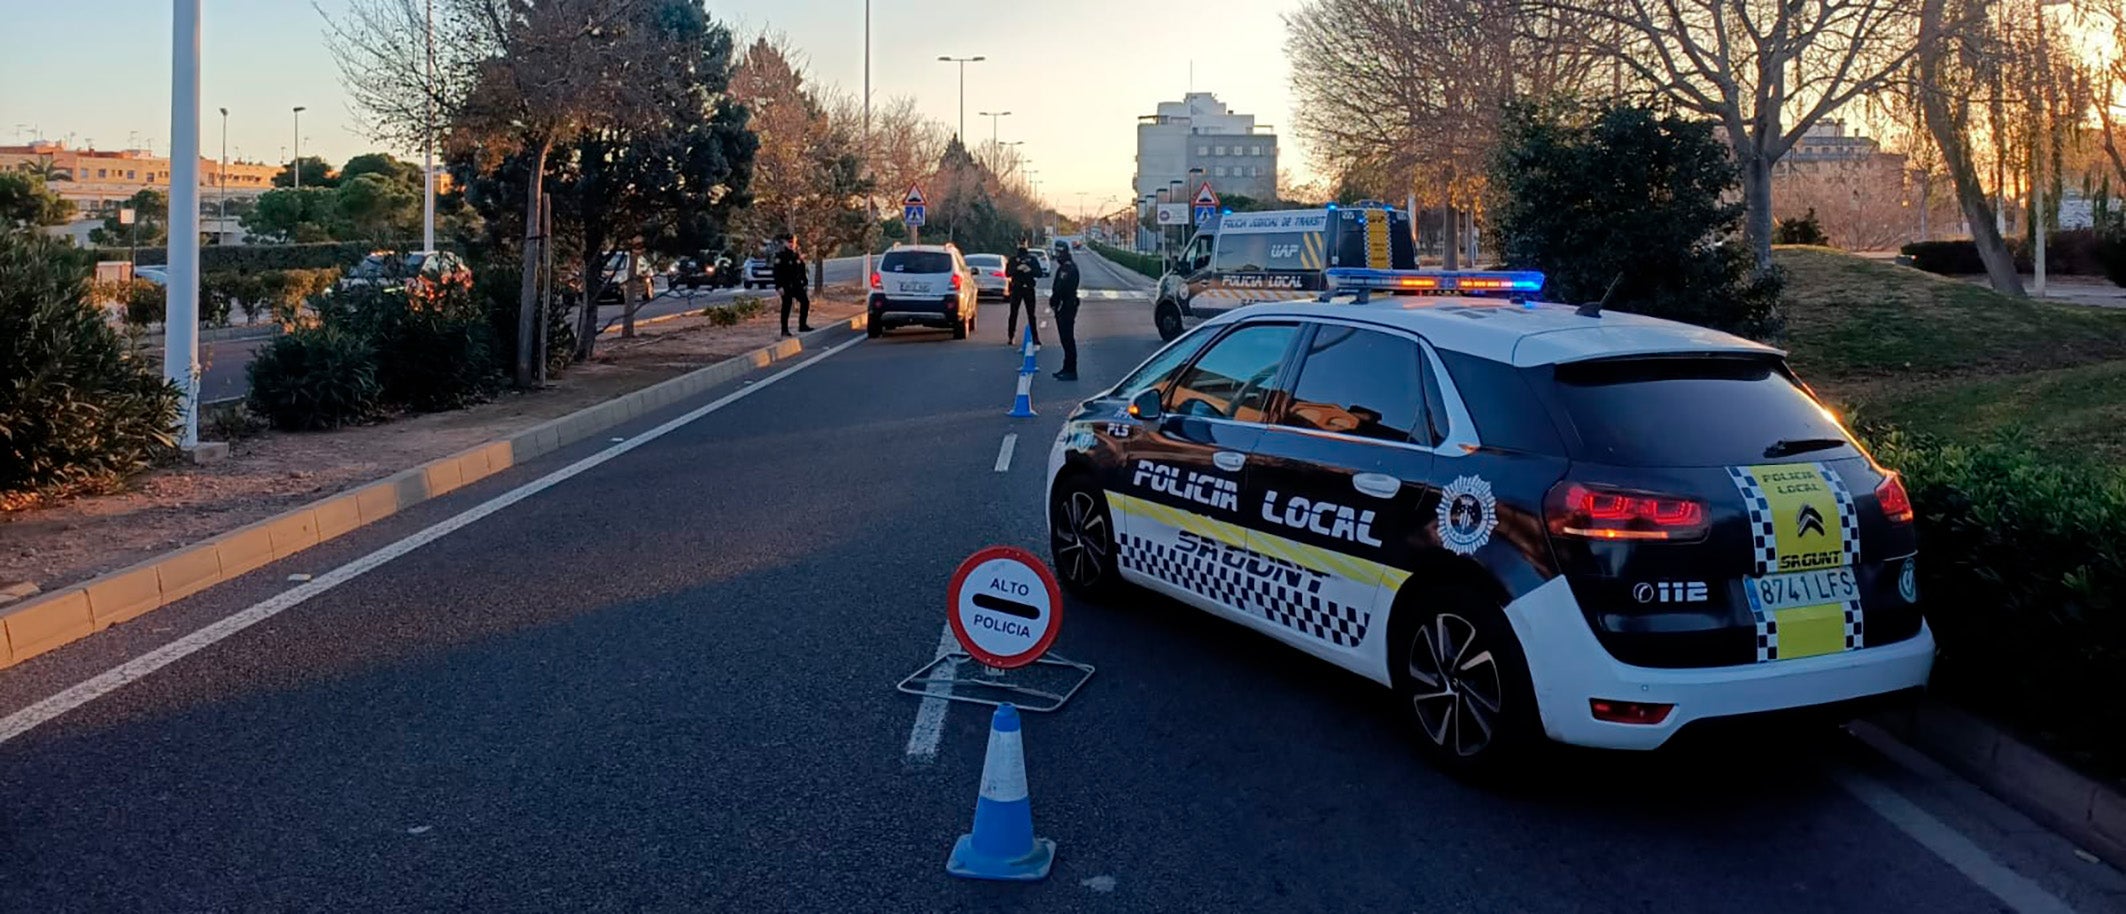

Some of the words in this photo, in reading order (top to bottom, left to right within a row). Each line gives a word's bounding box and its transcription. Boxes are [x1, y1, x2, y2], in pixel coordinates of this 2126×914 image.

[1222, 275, 1263, 288] POLICIA
[1268, 275, 1303, 288] LOCAL
[1107, 422, 1131, 438] PLS
[1762, 471, 1816, 483] POLICIA
[1777, 483, 1821, 495] LOCAL
[1133, 459, 1238, 513] POLICIA
[1261, 490, 1383, 548] LOCAL
[1780, 551, 1841, 569] SAGUNT
[989, 578, 1030, 597] ALTO
[1657, 581, 1708, 602] 112
[1760, 575, 1812, 605] 8741
[1815, 571, 1854, 599] LFS
[973, 614, 1031, 638] POLICIA
